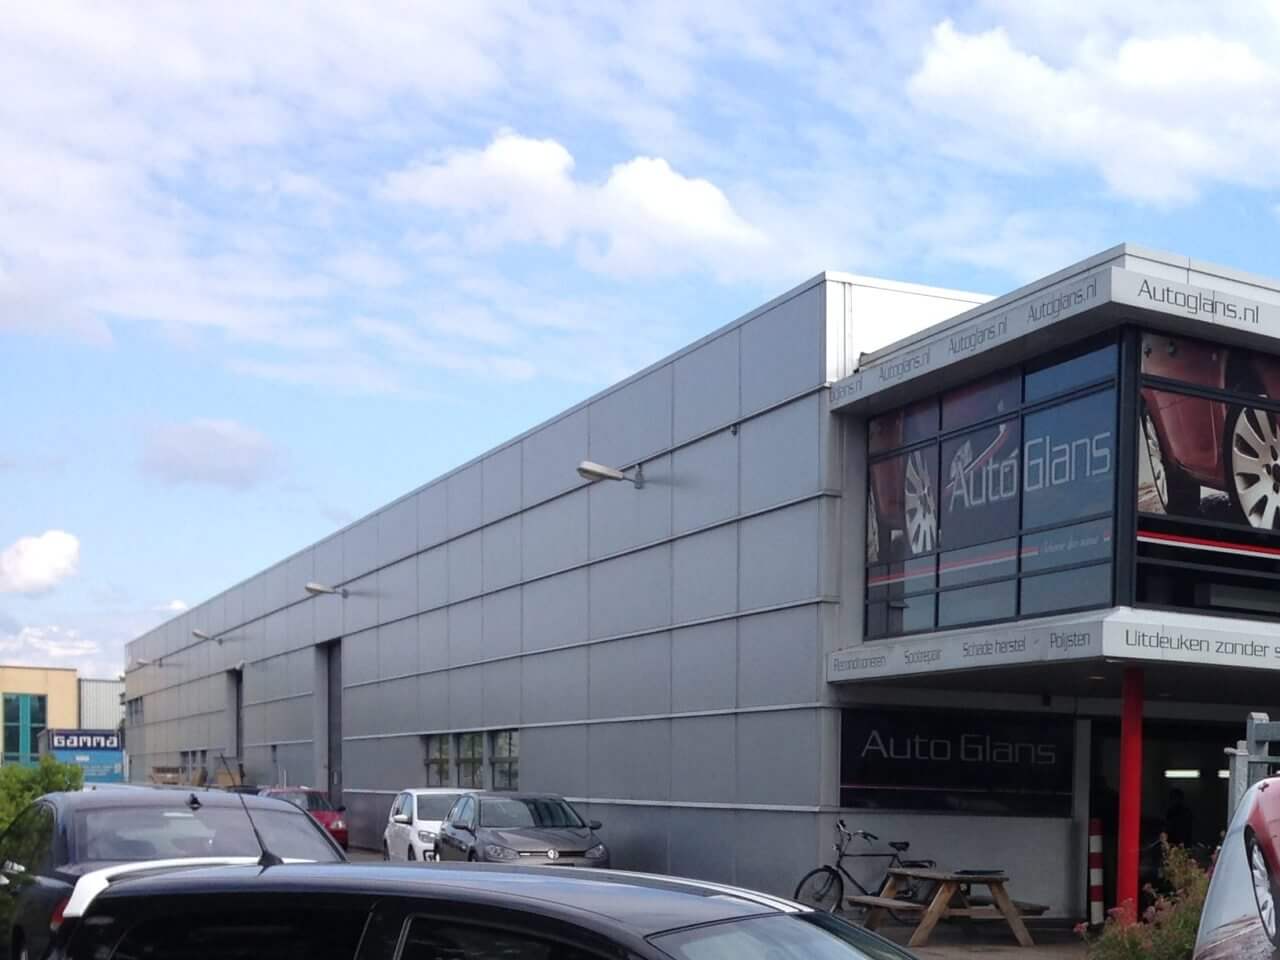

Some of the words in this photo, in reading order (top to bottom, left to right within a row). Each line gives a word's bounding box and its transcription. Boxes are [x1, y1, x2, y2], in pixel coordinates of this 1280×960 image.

[1137, 279, 1259, 323] Autoglans.nl
[879, 349, 930, 385] Autoglans.nl
[948, 317, 1008, 355] Autoglans.nl
[1027, 279, 1097, 322] Autoglans.nl
[1024, 432, 1111, 492] Glans
[1125, 629, 1210, 653] Uitdeuken
[1215, 639, 1270, 658] zonder
[861, 729, 951, 761] Auto
[960, 734, 1057, 765] Glans
